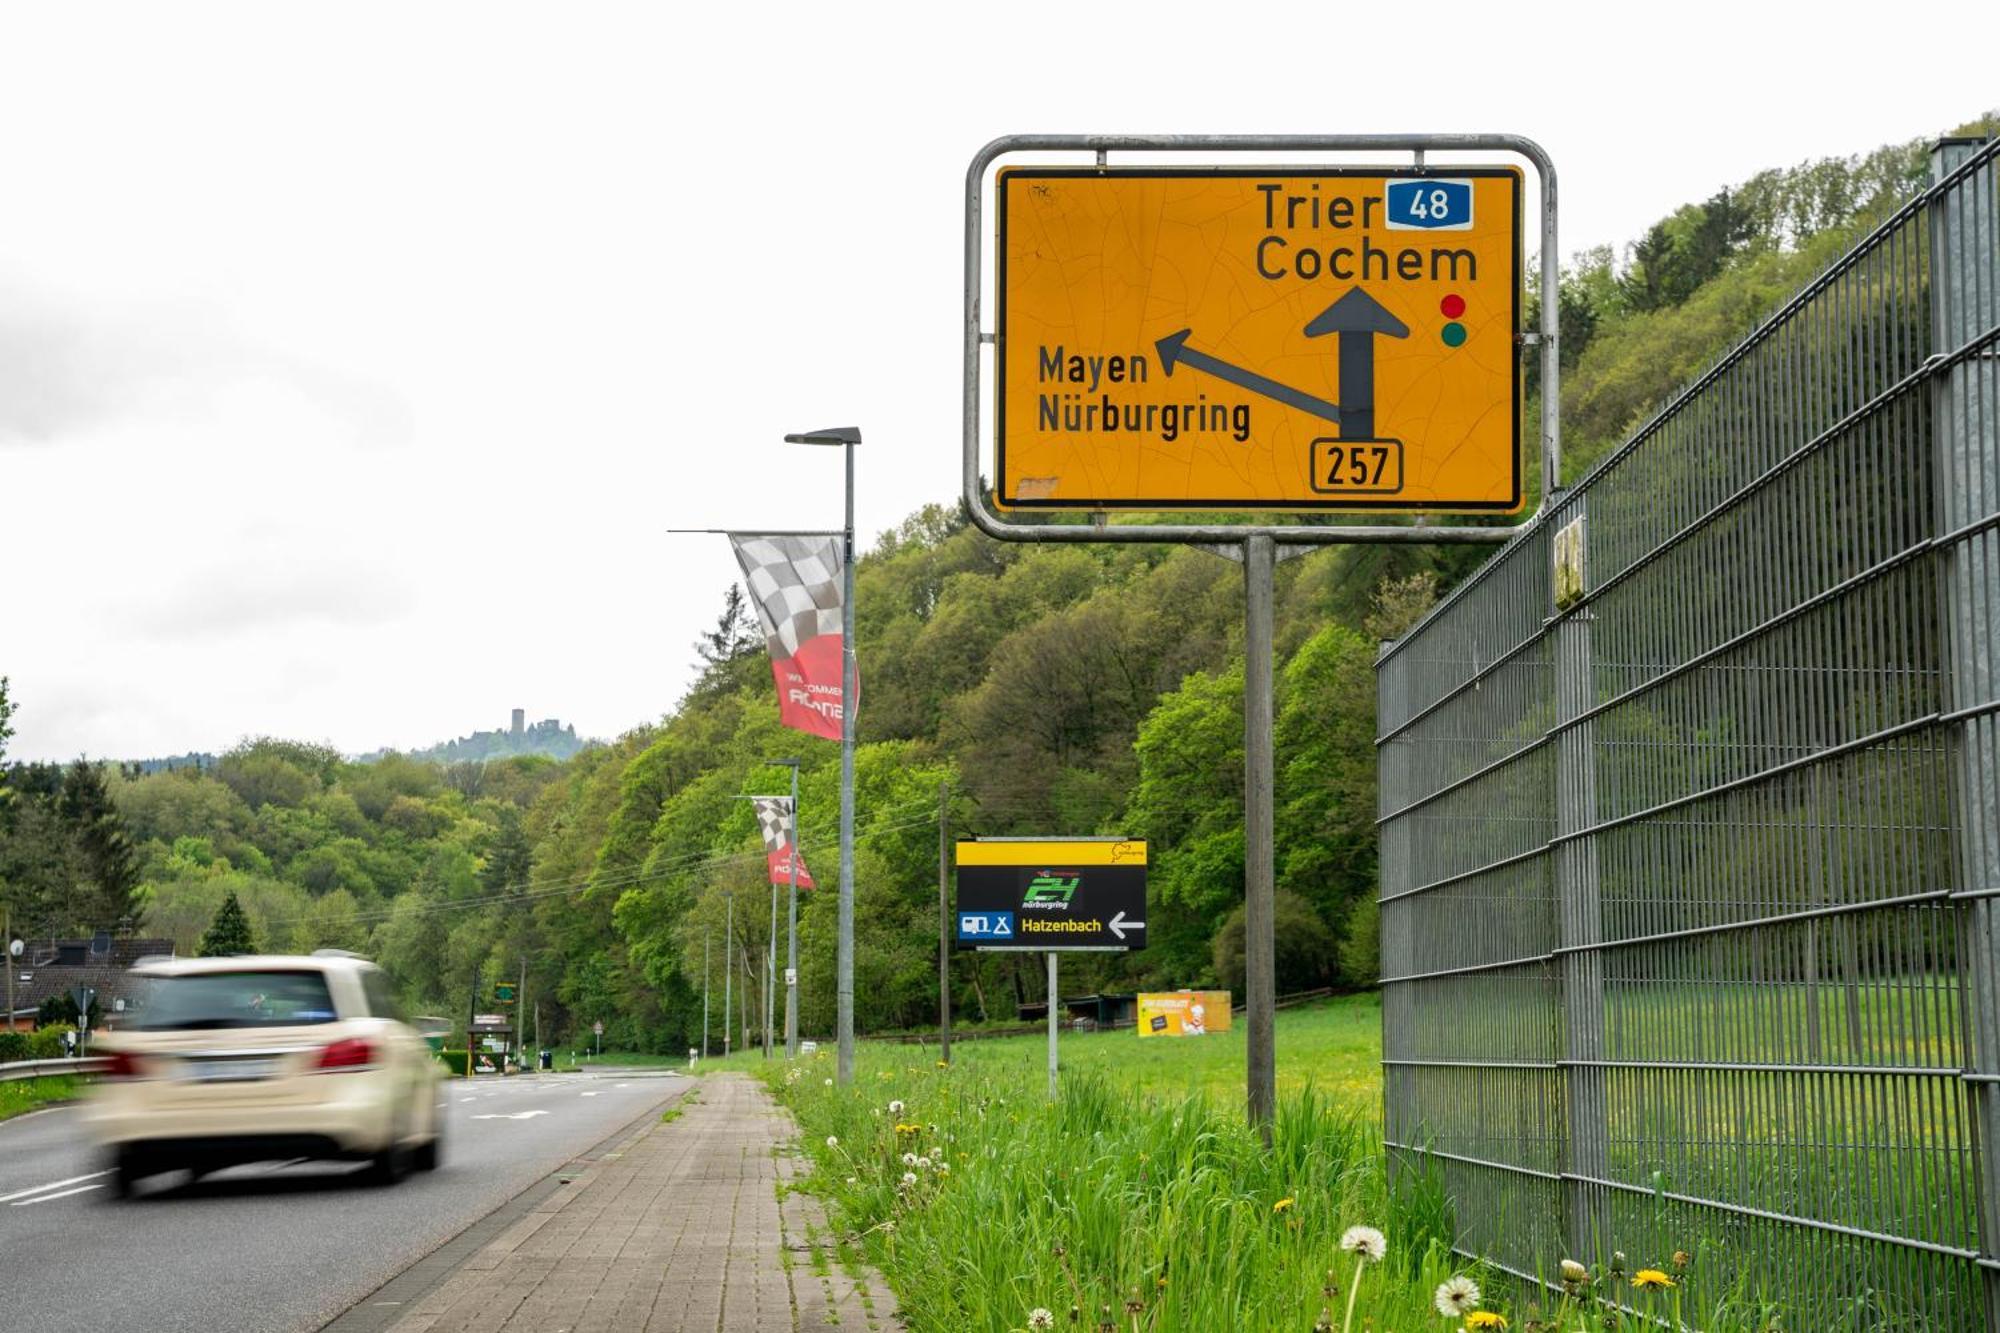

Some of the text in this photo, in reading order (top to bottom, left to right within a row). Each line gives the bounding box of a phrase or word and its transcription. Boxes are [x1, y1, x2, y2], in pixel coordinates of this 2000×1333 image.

[1257, 184, 1449, 229] Trier 48
[1256, 235, 1477, 281] Cochem
[1039, 345, 1147, 393] Mayen
[1039, 394, 1250, 442] Nürburgring
[1327, 446, 1389, 485] 257
[1021, 918, 1102, 933] Hatzenbach
